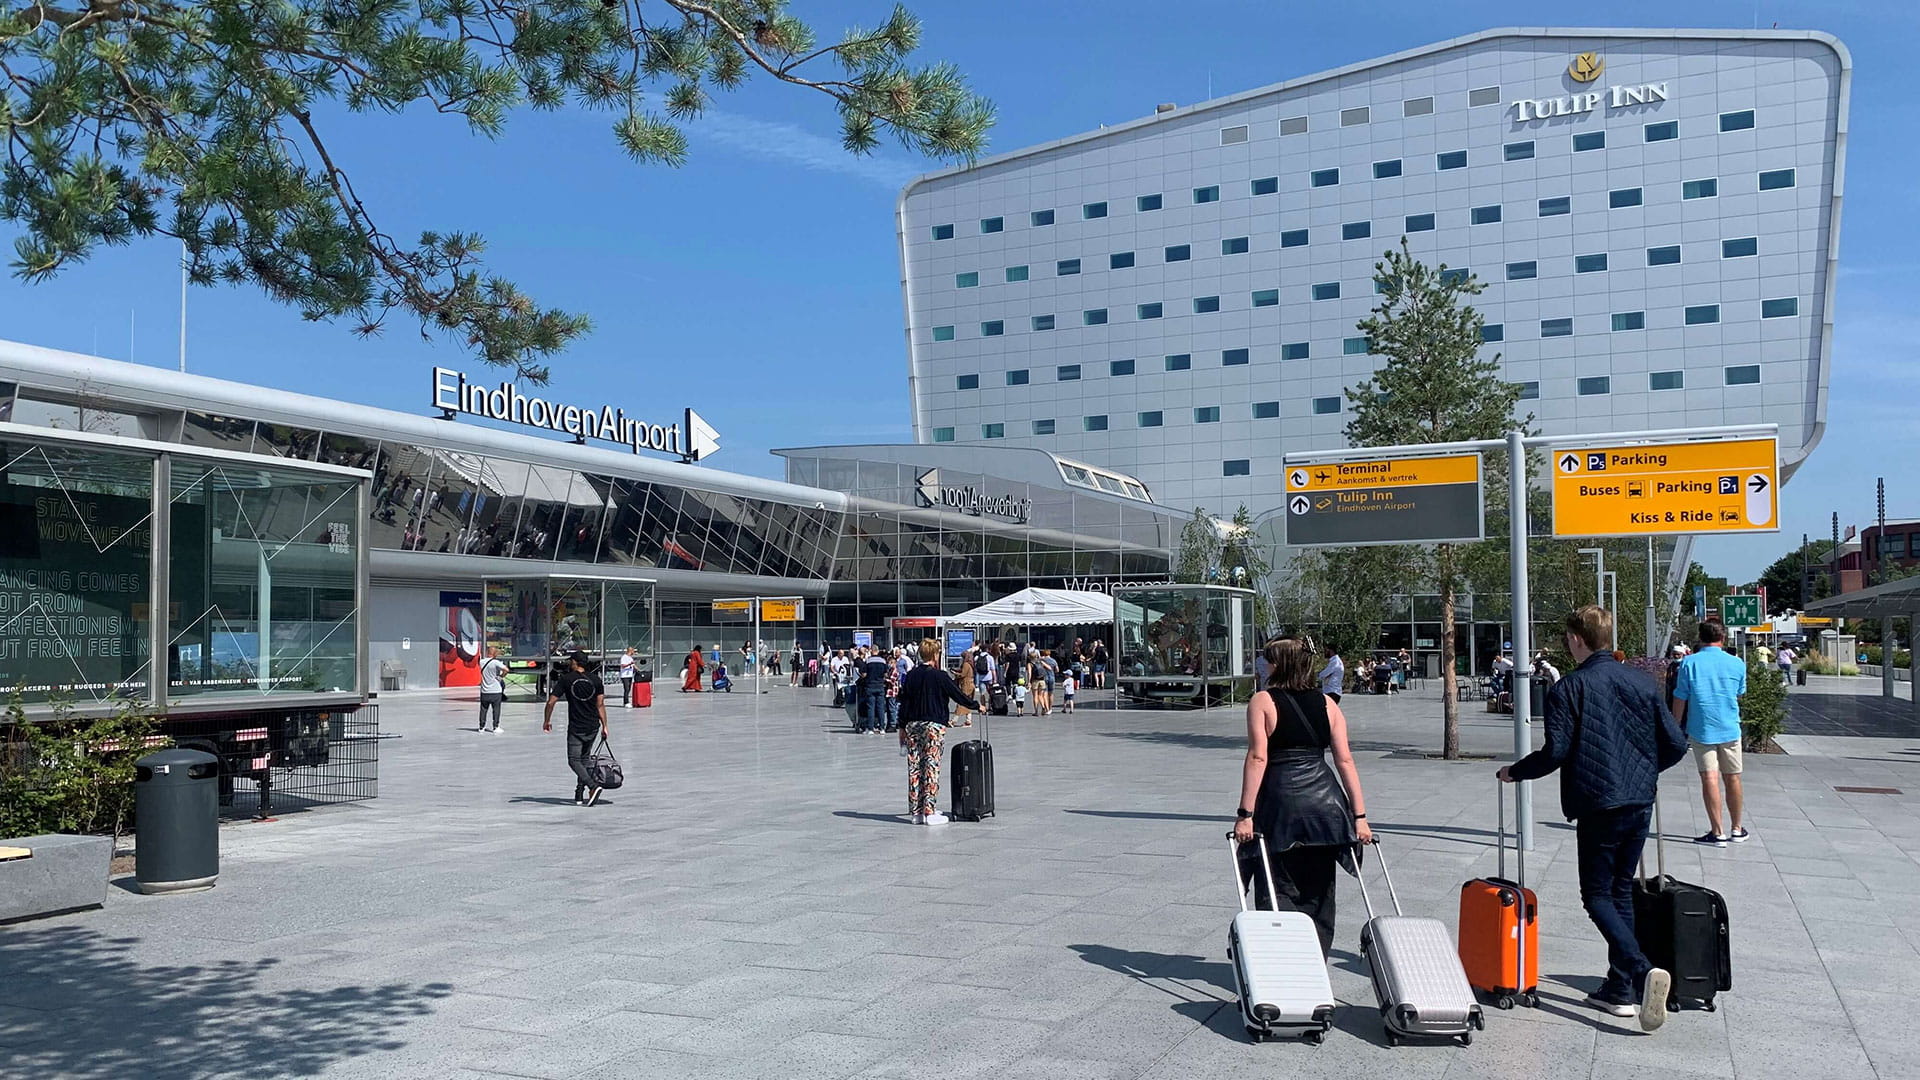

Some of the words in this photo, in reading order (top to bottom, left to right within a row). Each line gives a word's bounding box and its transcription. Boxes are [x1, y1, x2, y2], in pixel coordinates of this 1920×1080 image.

[432, 366, 682, 455] EindhovenAirport
[1611, 453, 1668, 467] Parking
[1336, 461, 1392, 476] Terminal
[1336, 476, 1378, 485] Aankomst
[1388, 473, 1418, 482] vertrek
[1579, 484, 1620, 497] Buses
[1656, 481, 1713, 494] Parking
[1336, 491, 1368, 504] Tulip
[1372, 490, 1394, 501] Inn
[1336, 503, 1382, 513] Eindhoven
[1384, 502, 1416, 511] Airport
[1630, 511, 1659, 524] Kiss
[1664, 512, 1675, 522] &
[1680, 509, 1713, 522] Ride
[77, 571, 141, 593] COMES
[1063, 577, 1176, 596] Welco
[29, 592, 85, 613] FROM
[27, 638, 82, 659] FROM
